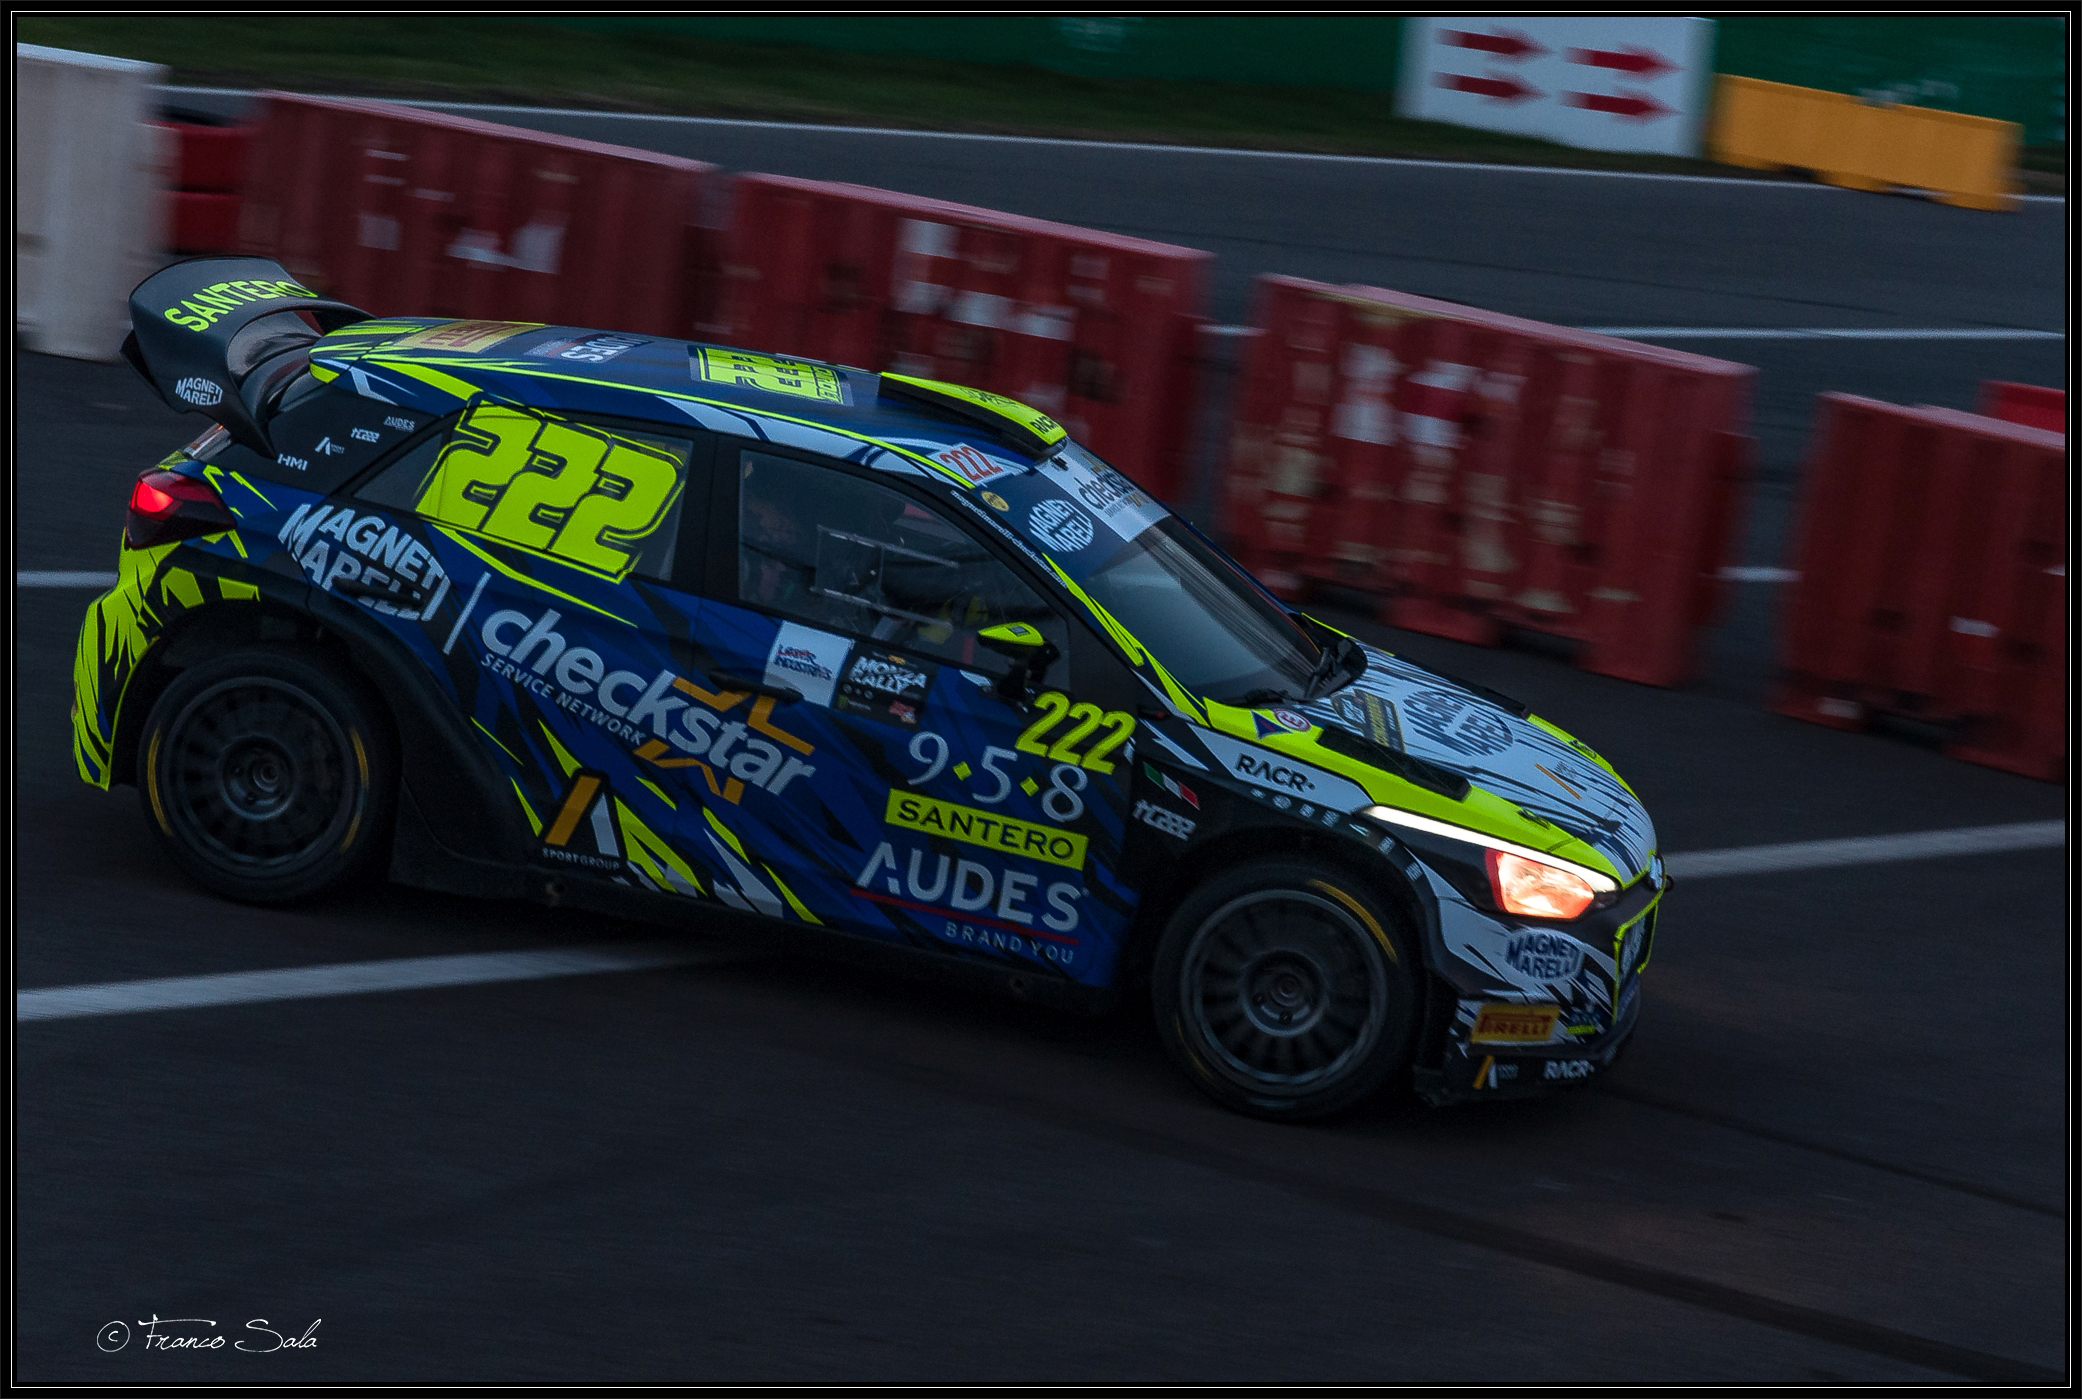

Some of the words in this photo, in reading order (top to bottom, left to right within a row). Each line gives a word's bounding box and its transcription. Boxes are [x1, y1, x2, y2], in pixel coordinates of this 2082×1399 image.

[164, 280, 319, 333] SANTERO
[174, 376, 224, 403] MAGNETI
[276, 452, 309, 472] HMI
[939, 445, 1004, 481] 222
[414, 404, 678, 576] 222
[854, 655, 928, 690] MONZA
[480, 652, 554, 698] SERVICE
[555, 690, 647, 746] NETWORK
[480, 608, 816, 797] checkstar
[1014, 690, 1136, 776] 222
[896, 800, 1074, 860] SANTERO
[855, 841, 1083, 933] AUDES
[944, 921, 1023, 952] BRAND
[1030, 941, 1076, 965] YOU
[1506, 933, 1582, 962] MAGNETI
[1508, 952, 1580, 980] MARELLI
